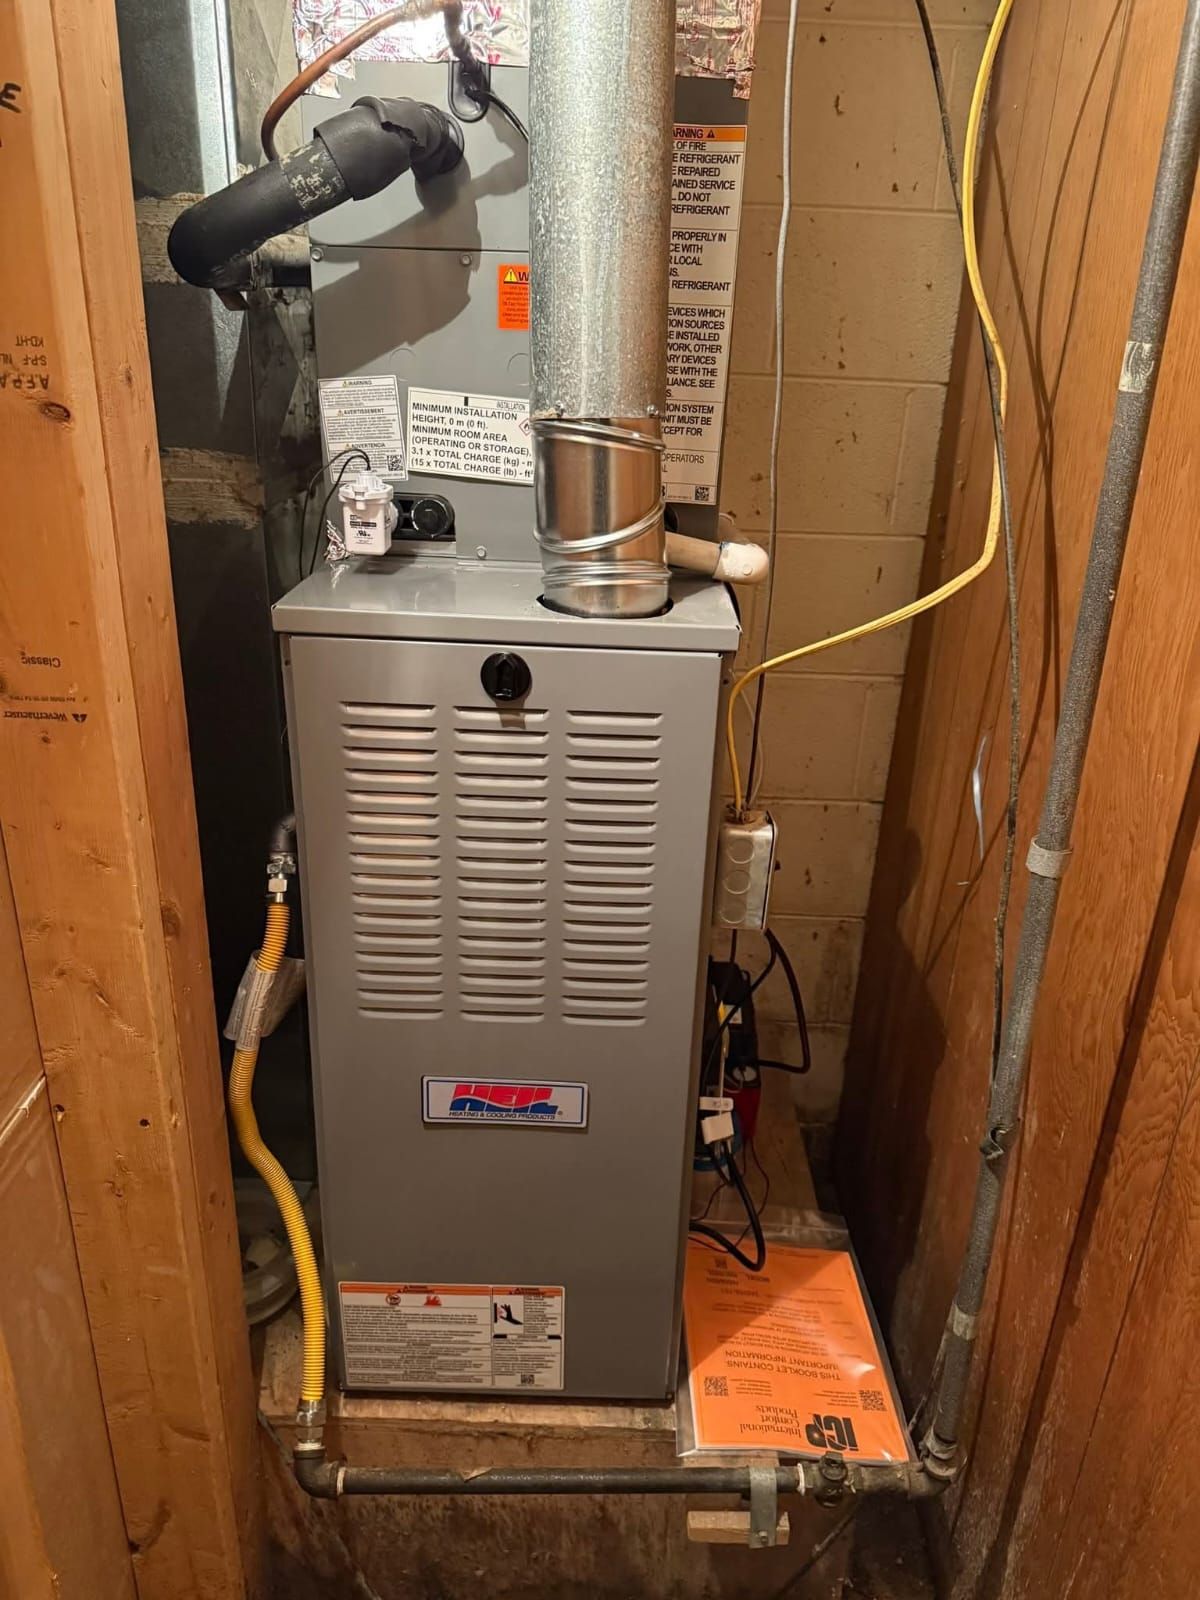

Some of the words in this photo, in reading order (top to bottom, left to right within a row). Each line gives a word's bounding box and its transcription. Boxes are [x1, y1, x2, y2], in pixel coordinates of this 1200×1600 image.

[673, 127, 703, 138] RNING
[676, 141, 687, 150] OF
[689, 142, 706, 150] FIRE
[680, 153, 740, 164] REFRIGERANT
[678, 166, 720, 176] REPAIRED
[672, 178, 697, 188] AINED
[700, 180, 736, 190] SERVICE
[678, 192, 691, 201] DO
[693, 193, 711, 202] NOT
[672, 231, 717, 242] PROPERLY
[718, 233, 726, 242] IN
[682, 244, 703, 254] WITH
[674, 256, 703, 265] LOCAL
[672, 280, 731, 291] REFRIGERANT
[668, 307, 696, 316] EVICES
[698, 308, 725, 318] WHICH
[684, 320, 725, 330] SOURCES
[676, 331, 720, 341] INSTALLED
[694, 344, 722, 354] OTHER
[682, 355, 716, 365] DEVICES
[667, 366, 679, 375] SE
[680, 366, 700, 376] WITH
[702, 368, 718, 377] THE
[667, 378, 697, 388] LIANCE.
[699, 379, 715, 388] SEE
[412, 402, 452, 413] MINIMUM
[454, 408, 517, 420] INSTALLATION
[682, 404, 714, 414] SYSTEM
[467, 420, 474, 429] (0
[662, 415, 676, 423] NIT
[677, 416, 700, 425] MUST
[701, 417, 712, 425] BE
[412, 425, 451, 436] MINIMUM
[454, 429, 480, 439] ROOM
[483, 433, 507, 442] AREA
[664, 426, 685, 435] CEPT
[686, 427, 702, 436] FOR
[412, 436, 465, 449] (OPERATING
[468, 442, 481, 450] OR
[411, 447, 423, 455] 3.1
[434, 449, 461, 460] TOTAL
[464, 453, 501, 463] CHARGE
[504, 456, 519, 467] (kg)
[411, 458, 424, 466] (15
[434, 460, 461, 470] TOTAL
[464, 464, 501, 474] CHARGE
[504, 466, 516, 477] (lb)
[21, 656, 61, 668] Classic
[726, 1351, 784, 1361] INFORMATION
[727, 1360, 774, 1370] CONTAINS
[776, 1366, 818, 1378] BOOKLET
[820, 1371, 841, 1380] THIS
[756, 1405, 798, 1418] Products
[760, 1415, 800, 1427] Comfort
[740, 1424, 801, 1438] International
[805, 1414, 859, 1451] ICP
